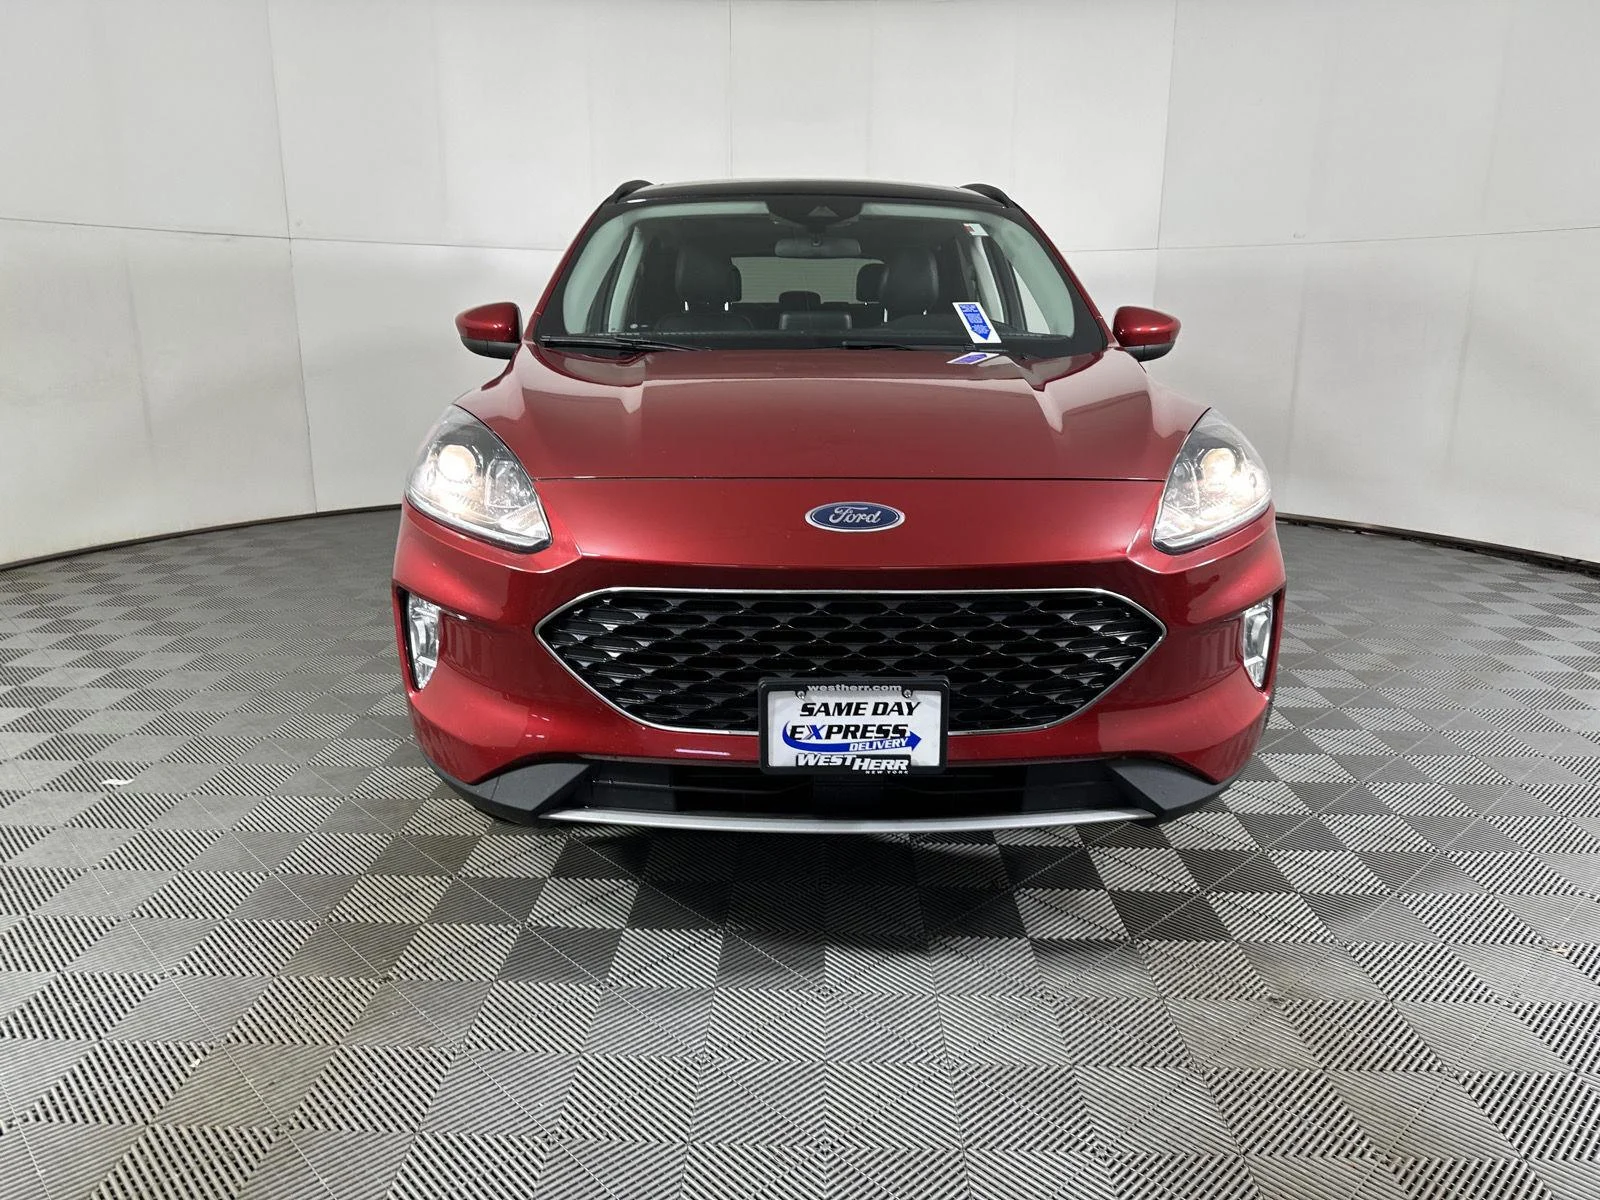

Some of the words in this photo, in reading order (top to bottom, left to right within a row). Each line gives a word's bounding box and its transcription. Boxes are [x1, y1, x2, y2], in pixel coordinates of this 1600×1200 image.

[829, 506, 882, 524] Ford
[807, 684, 902, 692] westherr.com
[800, 702, 868, 717] SAME
[872, 702, 921, 716] DAY
[789, 724, 909, 740] EXPRESS
[849, 739, 908, 752] DELIVERY
